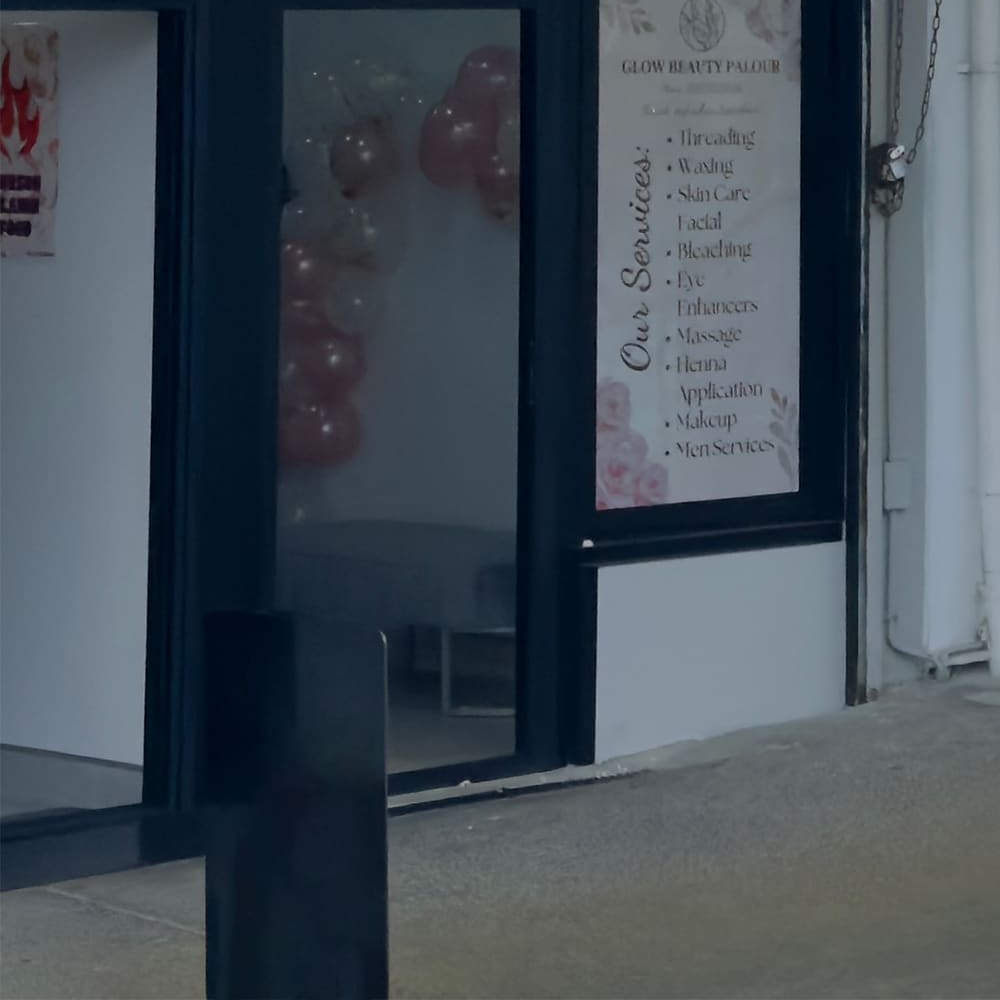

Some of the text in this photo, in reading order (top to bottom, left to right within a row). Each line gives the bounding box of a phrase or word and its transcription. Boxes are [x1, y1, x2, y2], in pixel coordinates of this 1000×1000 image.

[621, 58, 780, 75] GLOW BEAUTY PALOUR
[679, 128, 756, 150] Threading
[678, 157, 734, 179] Waxing
[678, 183, 751, 202] Skin Care
[678, 210, 722, 232] Facial
[678, 239, 753, 263] Bleaching
[678, 271, 705, 292] Eye
[677, 297, 759, 317] Enhancers
[620, 302, 652, 372] Our
[677, 327, 743, 348] Massage
[677, 355, 728, 374] Henna
[680, 381, 764, 406] Application
[676, 409, 738, 432] Makeup
[676, 437, 776, 458] Men Services
